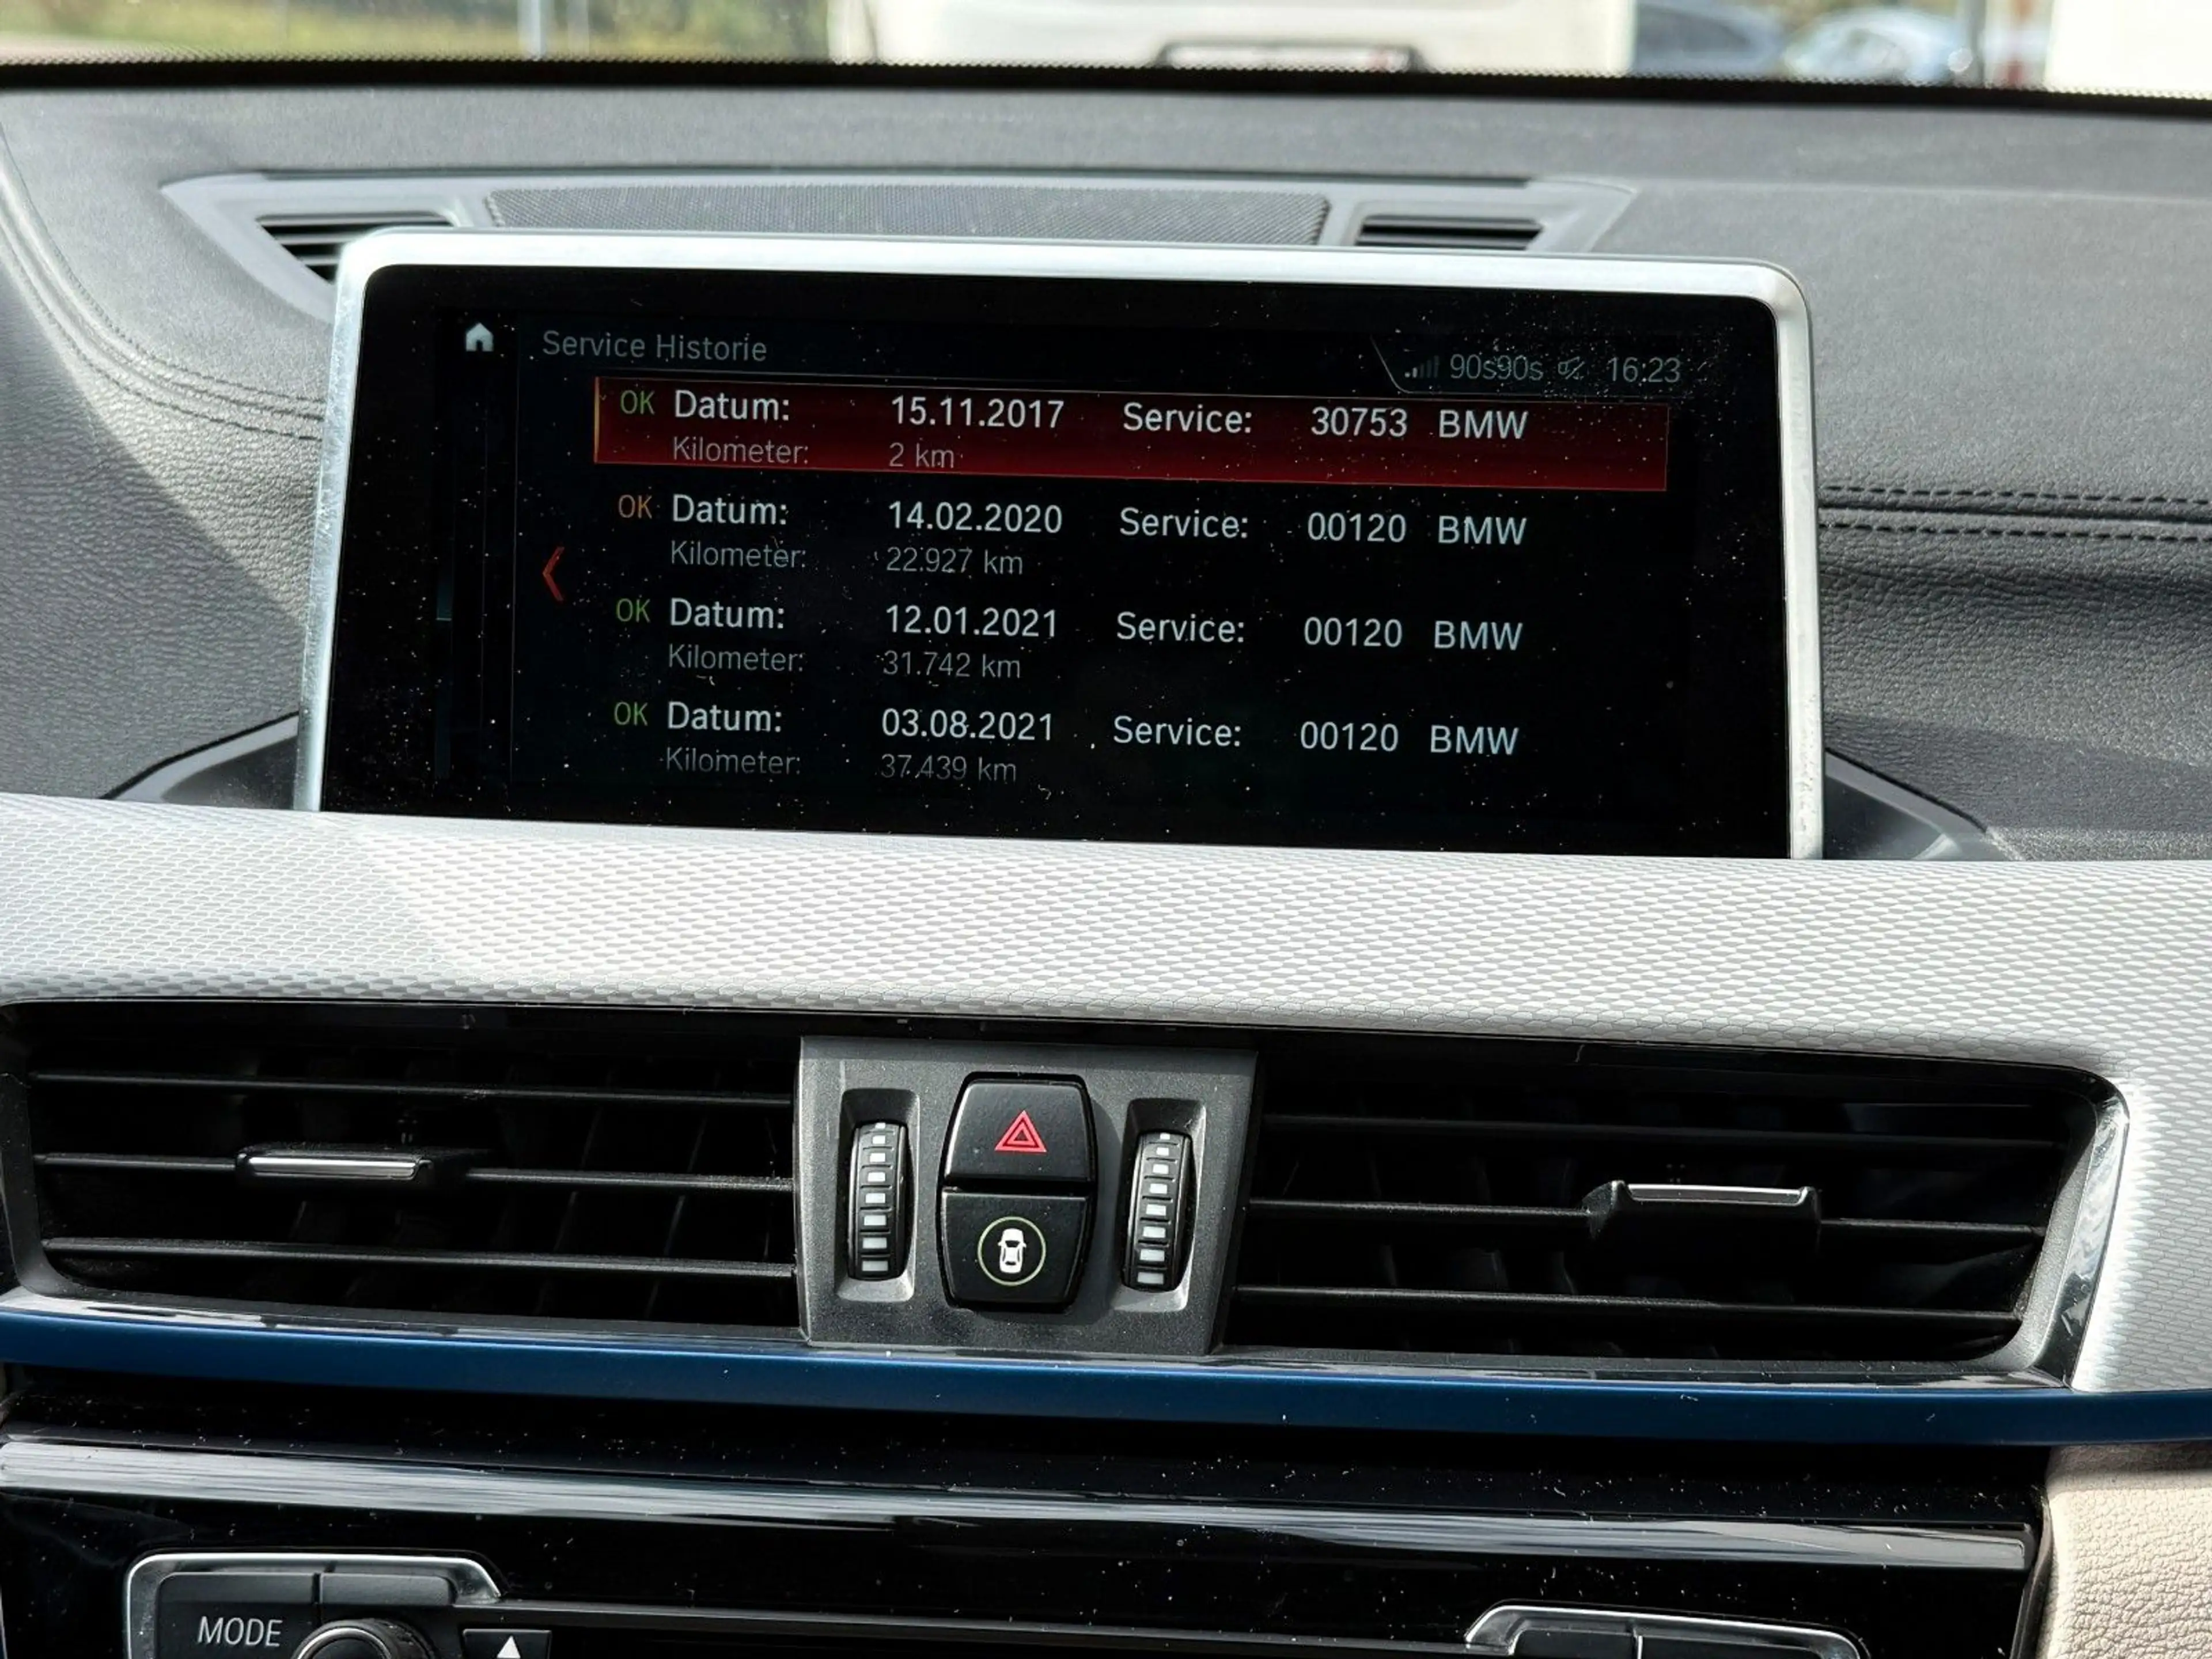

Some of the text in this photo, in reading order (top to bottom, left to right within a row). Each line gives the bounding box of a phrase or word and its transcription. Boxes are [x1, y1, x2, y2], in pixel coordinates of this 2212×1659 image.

[543, 331, 767, 362] Service Historie
[1450, 354, 1543, 381] 90s90s
[1608, 357, 1681, 383] 16:23
[620, 390, 1527, 440] OK Datum: 15.11.2017 Service: 30753 BMW
[674, 437, 955, 468] Kilometer: 2 km
[618, 495, 1527, 546] OK Datum: 14.02.2020 Service: 00120 BMW
[671, 541, 1022, 574] Kilometer: 22.927 km
[617, 598, 1522, 650] OK Datum: 12.01.2021 Service: 00120 BMW
[669, 645, 1020, 677] Kilometer: 31.742 km
[614, 702, 1519, 755] OK Datum: 03.08.2021 Service: 00120 BMW
[667, 748, 1016, 782] Kilometer: 37.439 km
[198, 1616, 283, 1646] MODE
